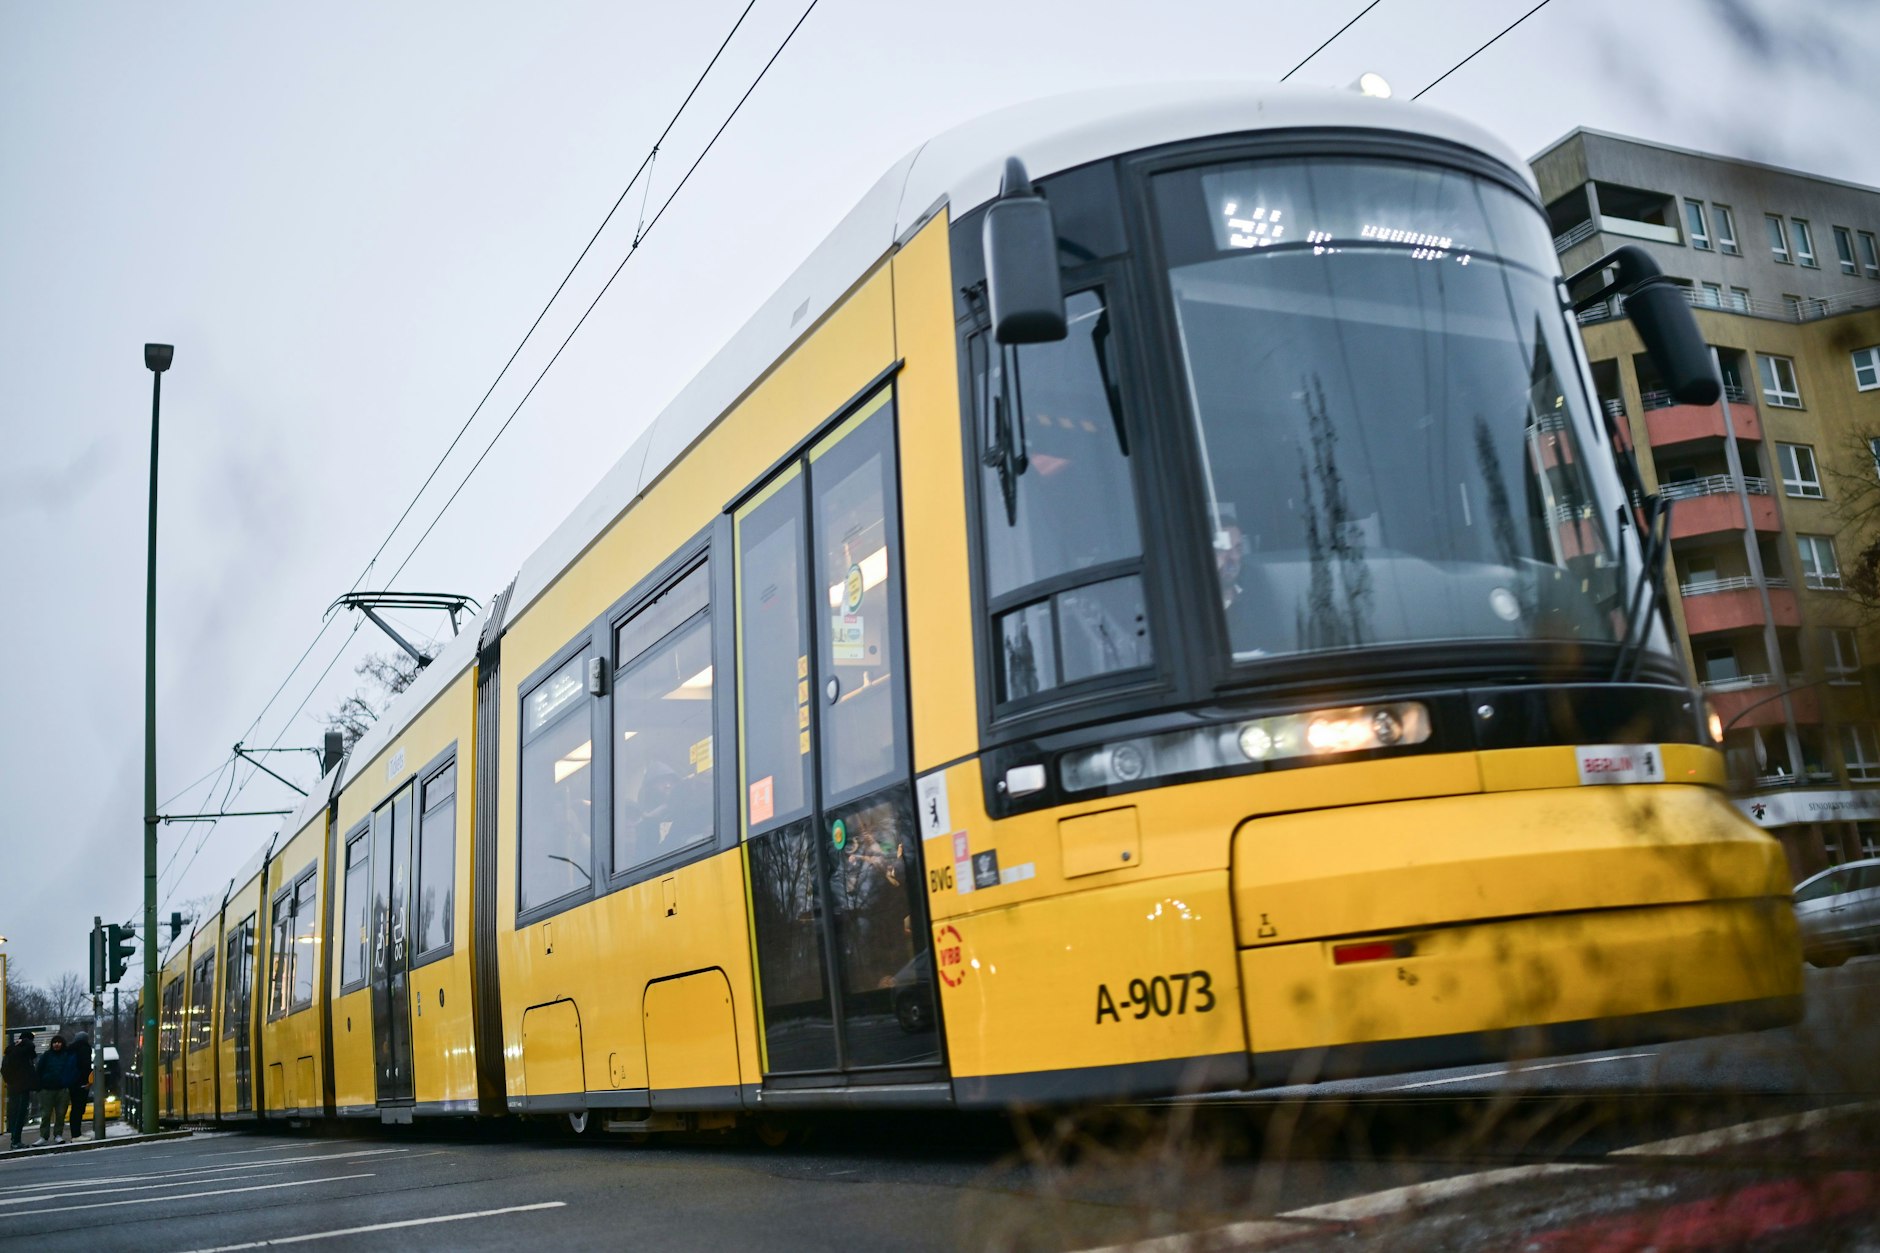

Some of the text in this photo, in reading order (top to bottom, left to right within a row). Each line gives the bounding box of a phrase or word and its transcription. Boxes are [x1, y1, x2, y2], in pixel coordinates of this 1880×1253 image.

[1583, 755, 1633, 773] BERLIN
[930, 866, 953, 893] BVG
[940, 946, 961, 966] VBB
[1096, 970, 1216, 1025] A-9073
